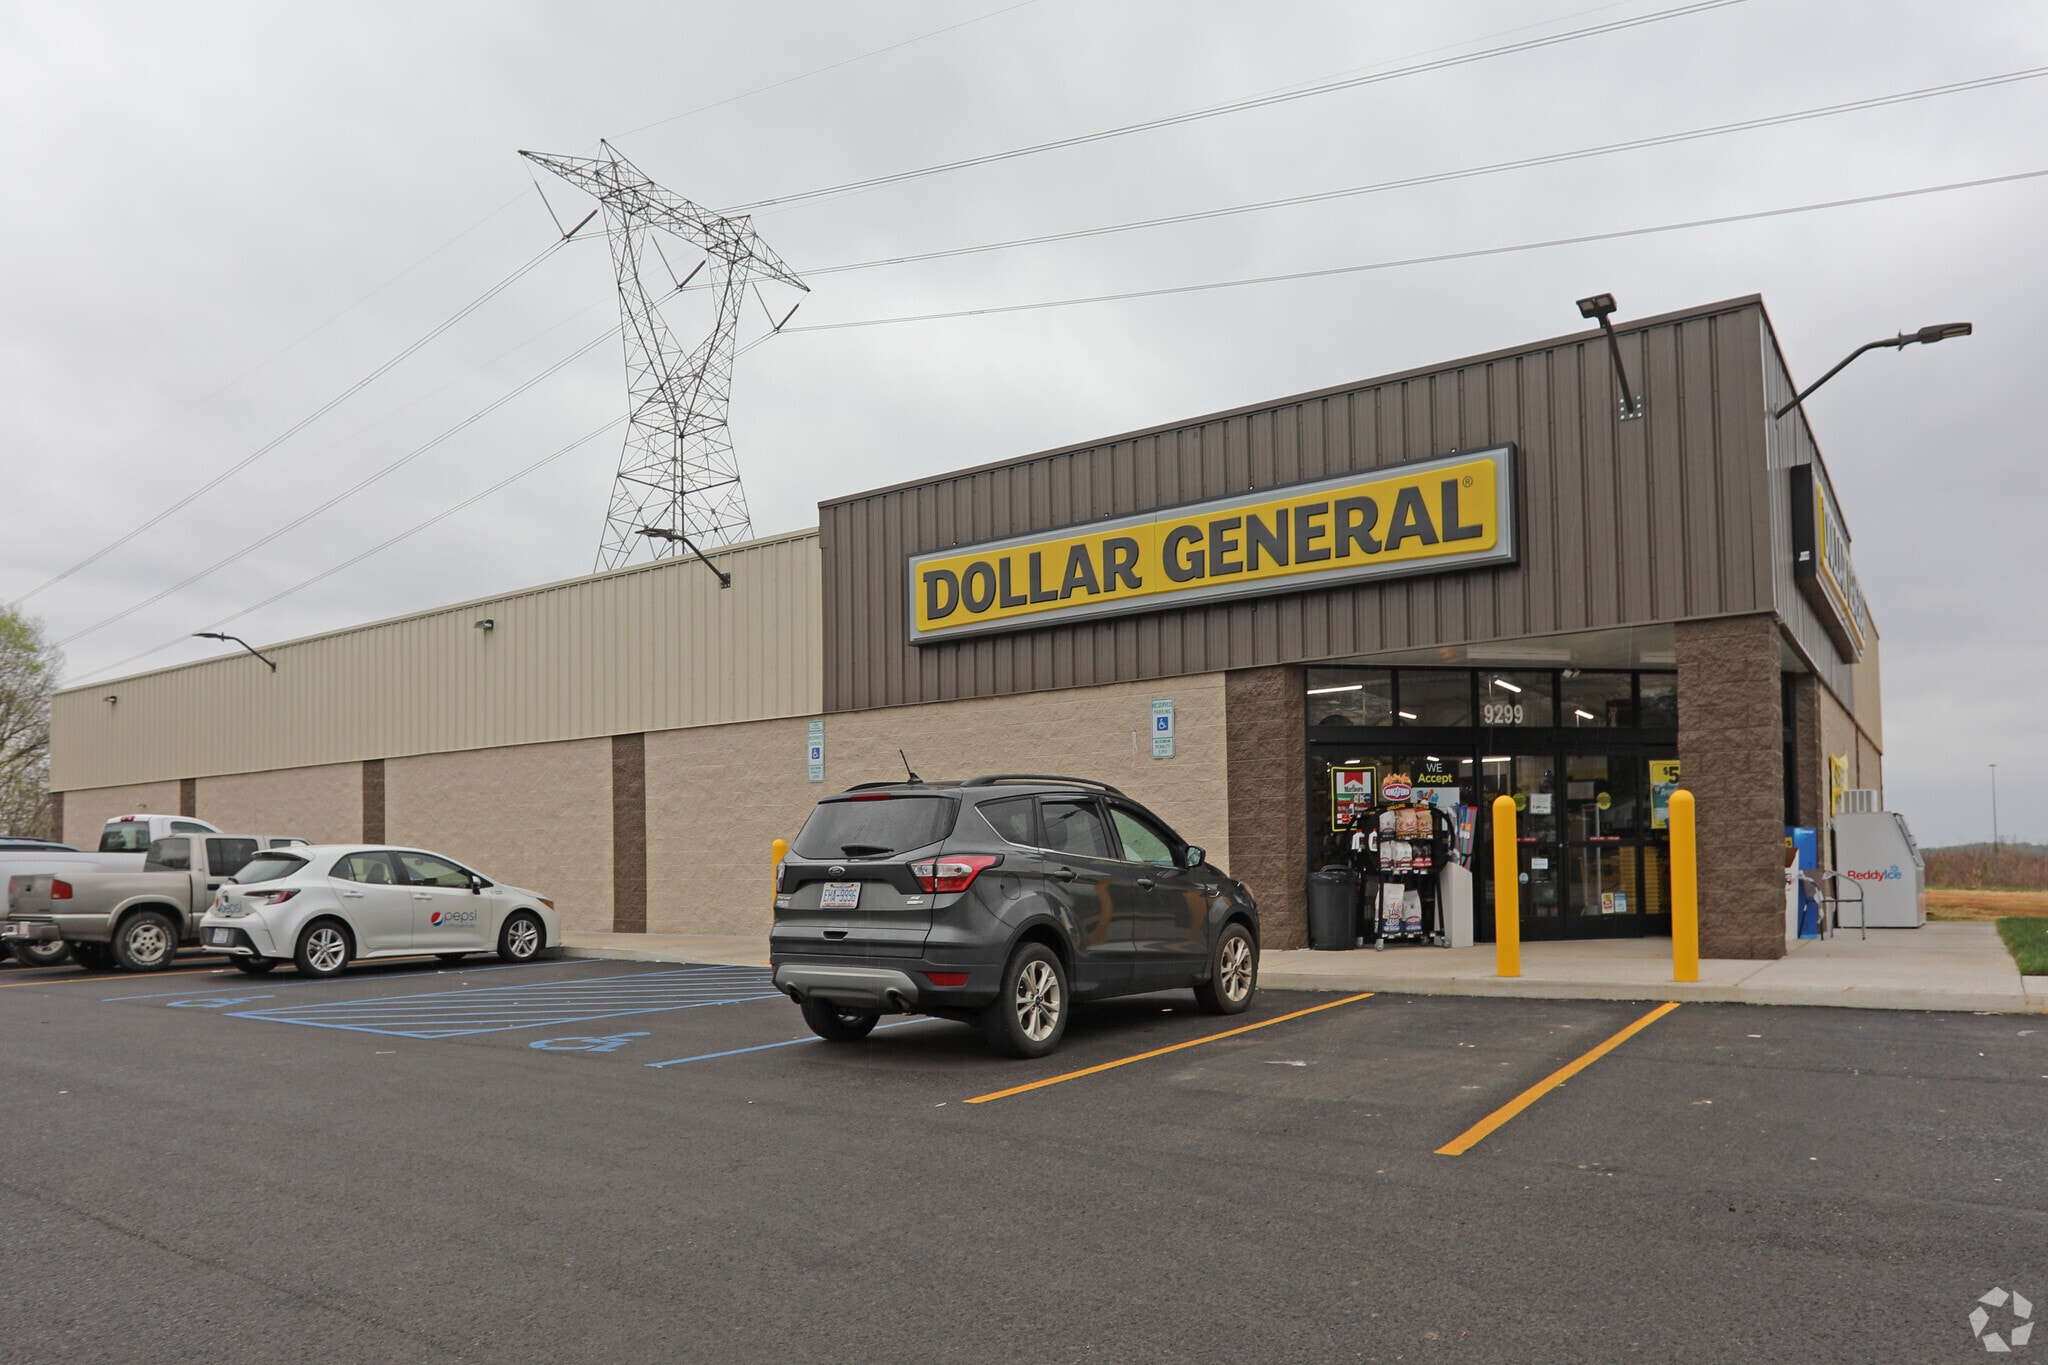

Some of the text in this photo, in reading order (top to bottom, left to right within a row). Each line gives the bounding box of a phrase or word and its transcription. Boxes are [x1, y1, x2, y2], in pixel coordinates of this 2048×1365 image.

[922, 536, 1143, 620] DOLLAR
[1162, 478, 1483, 583] GENERAL
[1484, 704, 1523, 724] 9299
[1426, 763, 1443, 773] WE
[1418, 773, 1453, 784] Accept
[443, 909, 477, 923] pepsi
